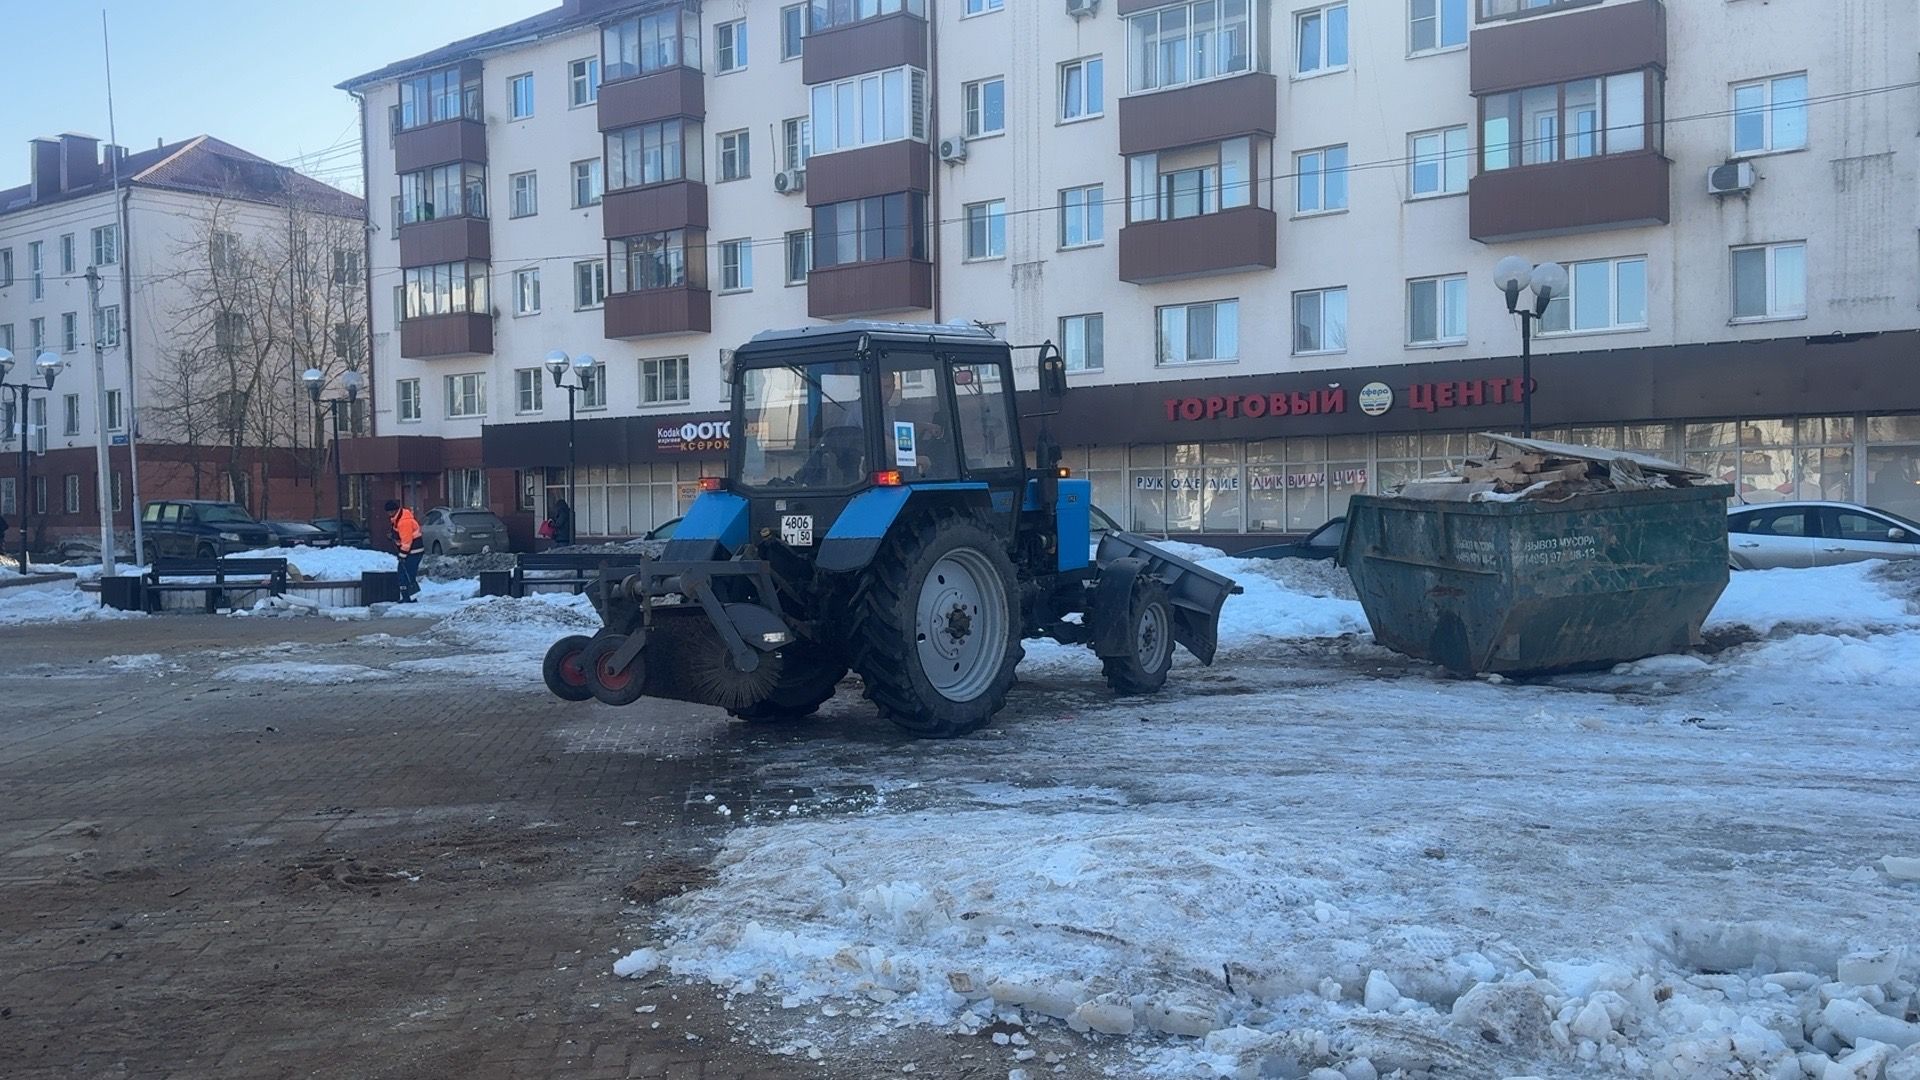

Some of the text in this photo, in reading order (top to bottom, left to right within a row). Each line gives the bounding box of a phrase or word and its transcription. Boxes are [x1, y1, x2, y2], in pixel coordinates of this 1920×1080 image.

[1165, 377, 1538, 421] ТОРГОВЫЙ ЦЕНТР
[657, 427, 680, 438] Kodak
[785, 516, 809, 529] 4806
[800, 531, 810, 541] 50
[1524, 535, 1595, 551] ВЫВОЗ МУСОРА
